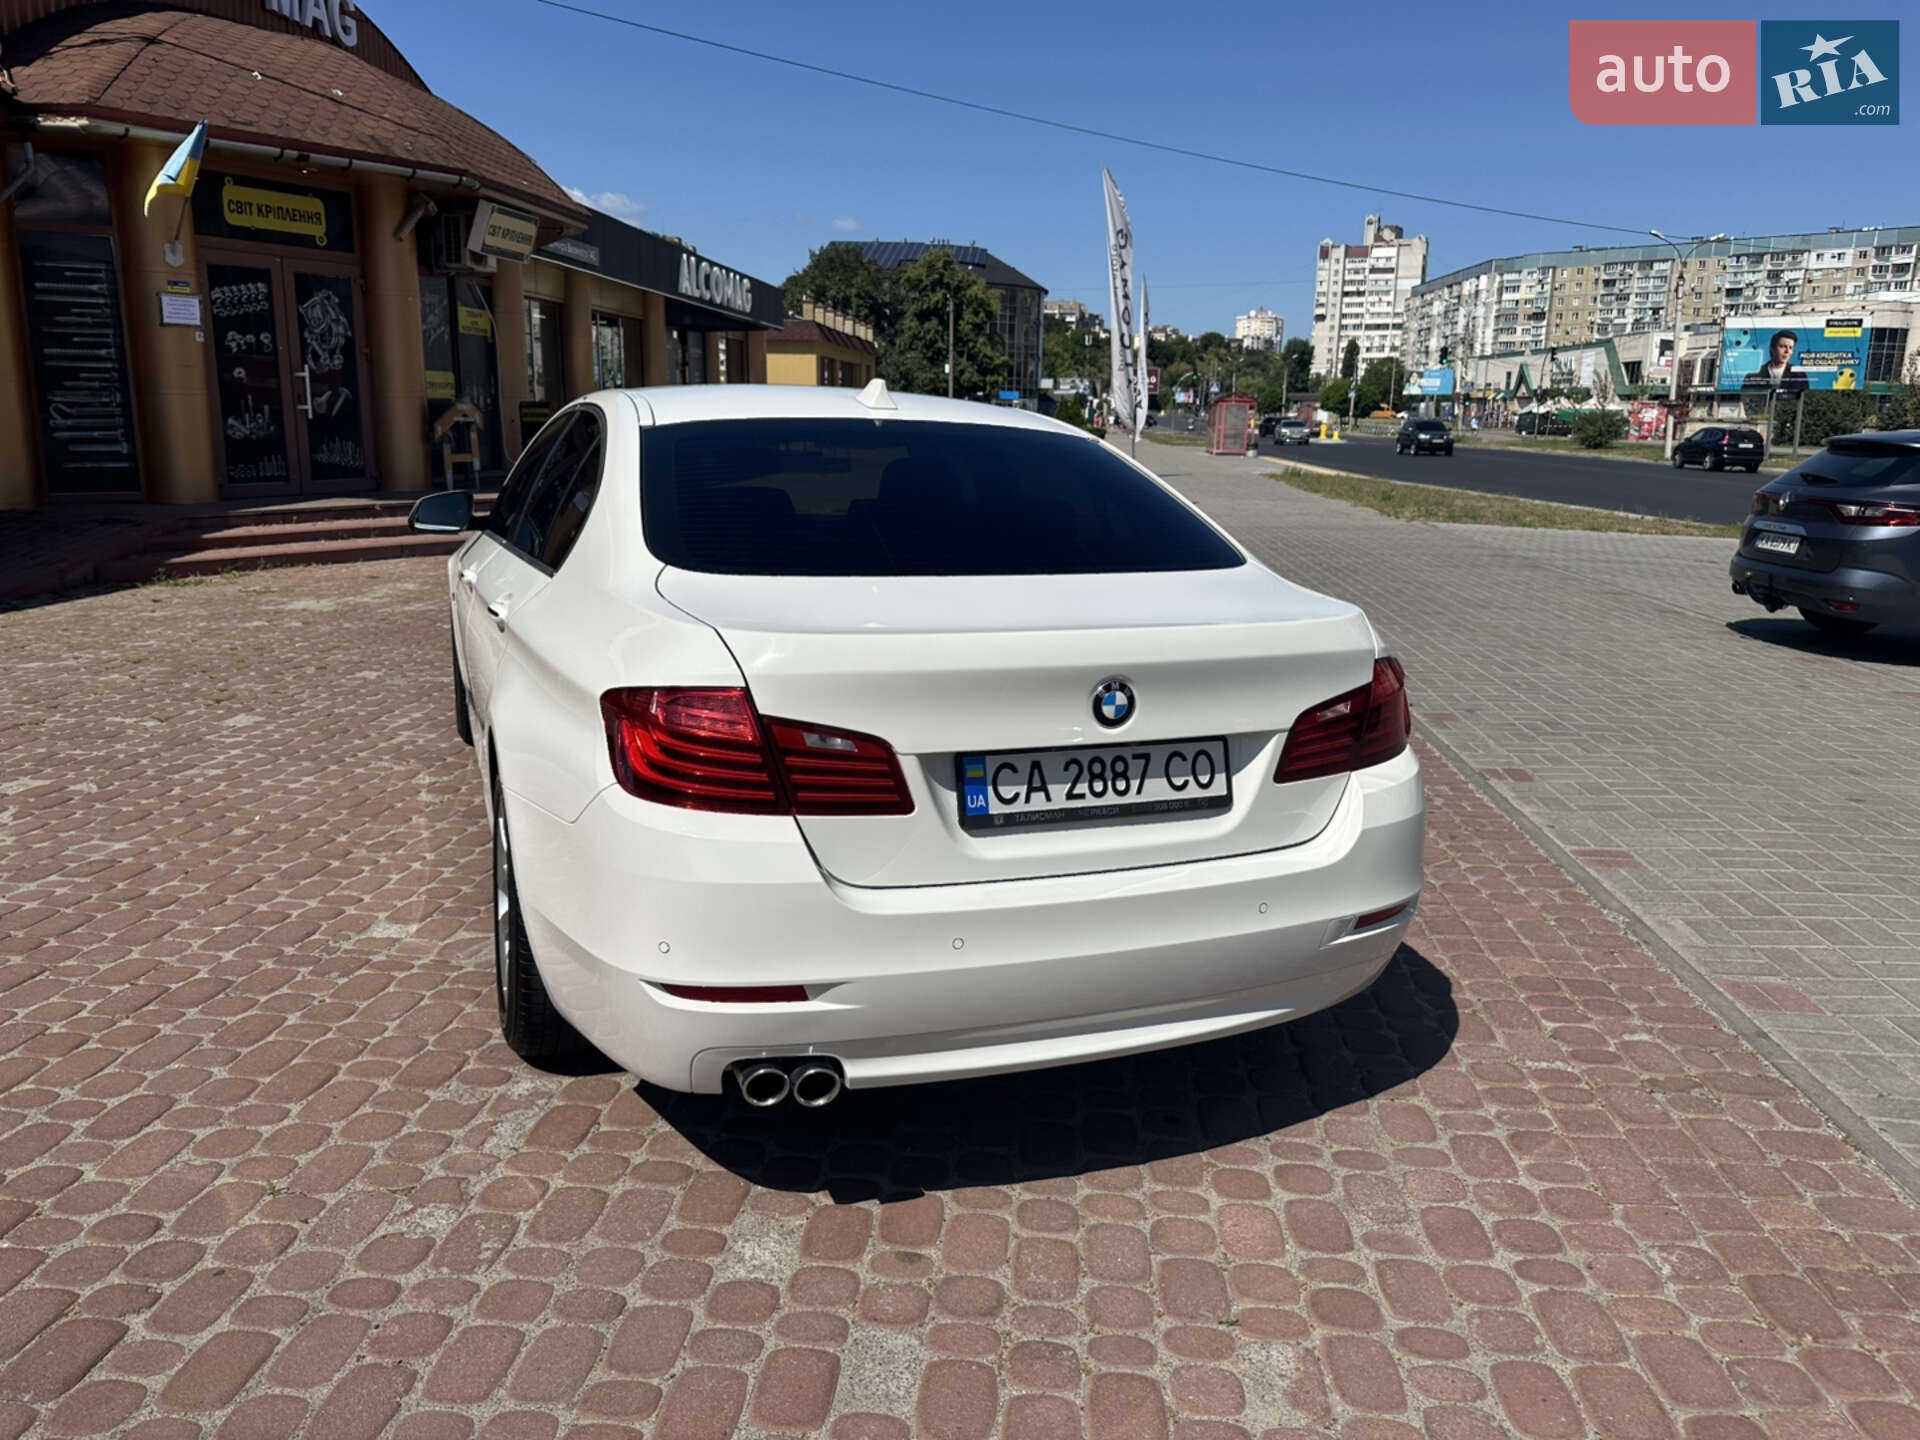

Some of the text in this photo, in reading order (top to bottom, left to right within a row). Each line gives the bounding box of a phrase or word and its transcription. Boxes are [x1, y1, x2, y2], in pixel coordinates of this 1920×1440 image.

[227, 199, 323, 226] СВІТ КРІПЛЕННЯ
[678, 252, 753, 313] ALCOMAG
[991, 749, 1216, 805] CA 2887 CO
[967, 795, 986, 808] UA
